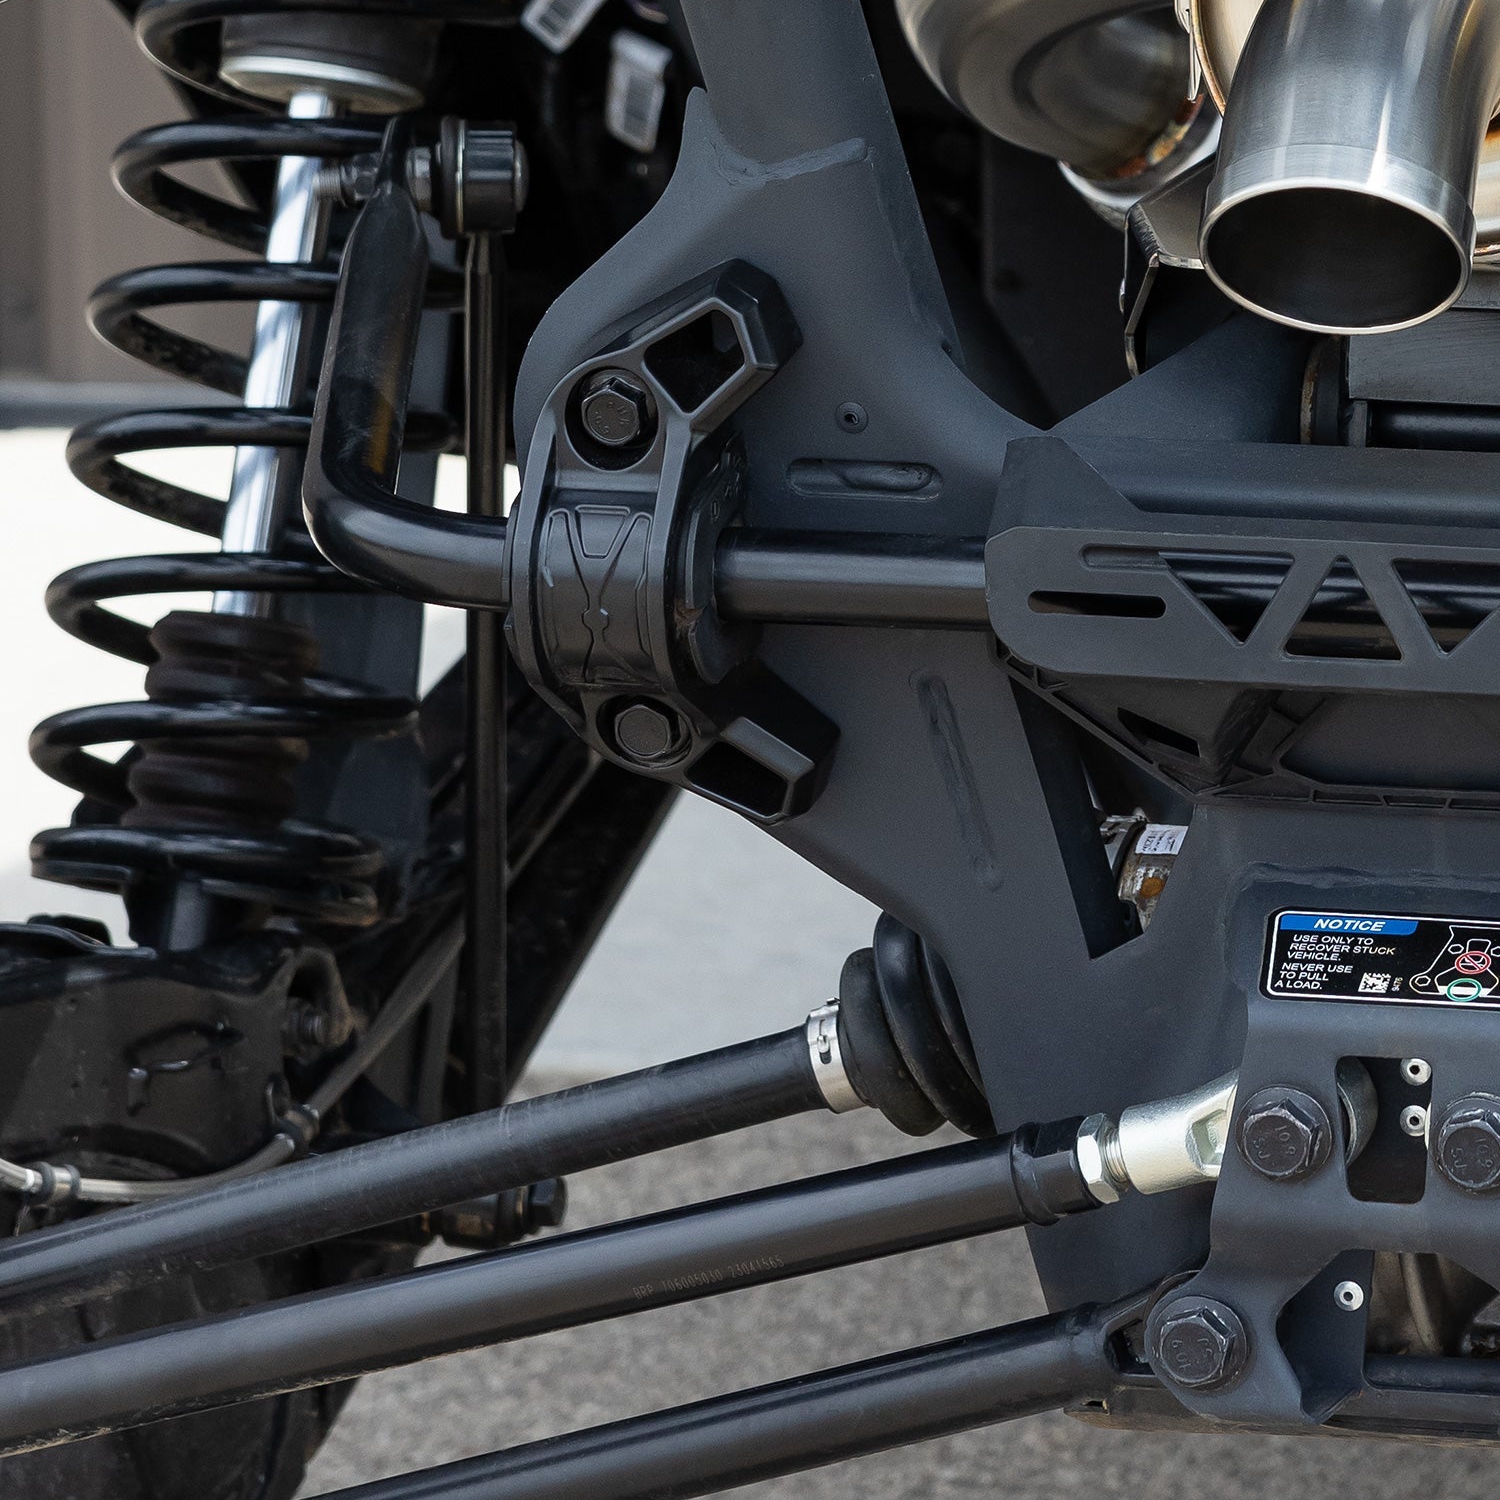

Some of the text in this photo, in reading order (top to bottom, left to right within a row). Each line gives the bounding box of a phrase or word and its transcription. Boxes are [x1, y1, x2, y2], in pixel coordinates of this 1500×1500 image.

[1313, 918, 1386, 932] NOTICE
[1293, 933, 1374, 946] USE ONLY TO
[1287, 950, 1341, 961] VEHICLE.
[1289, 943, 1396, 956] RECOVER STUCK
[1281, 962, 1354, 974] NEVER USE
[1279, 970, 1329, 981] TO PULL
[1274, 979, 1323, 991] A LOAD.
[631, 1284, 654, 1300] BRP
